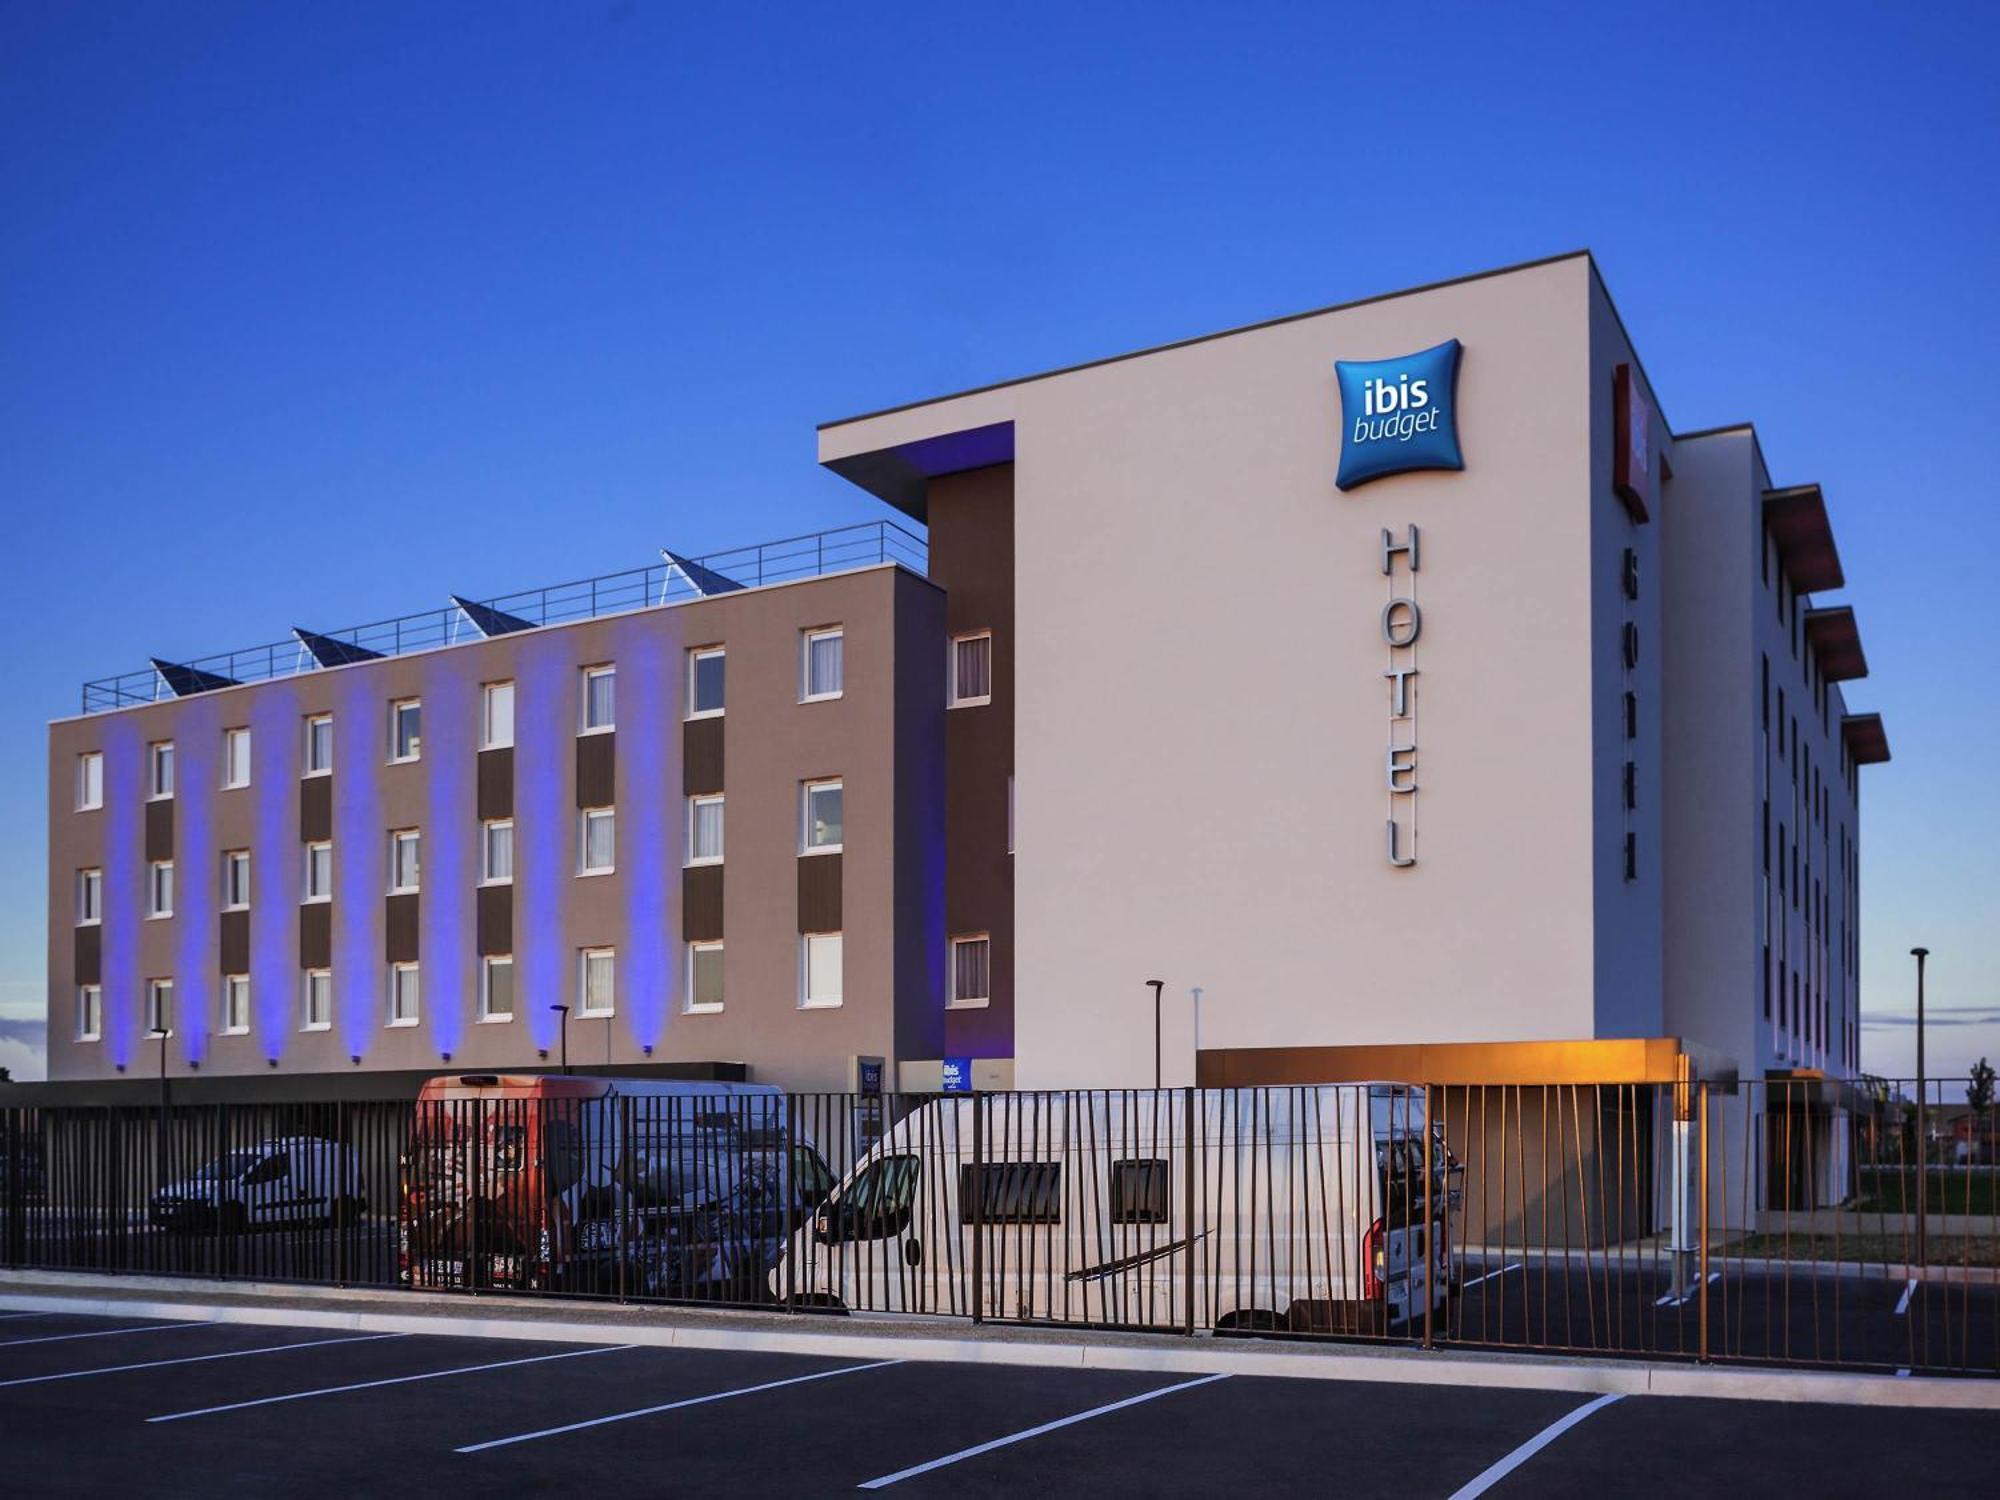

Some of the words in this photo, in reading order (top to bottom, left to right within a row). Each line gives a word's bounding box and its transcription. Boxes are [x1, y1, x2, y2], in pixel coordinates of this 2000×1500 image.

[1364, 374, 1428, 416] ibis
[1353, 406, 1440, 443] budget
[1381, 523, 1421, 868] HOTEL
